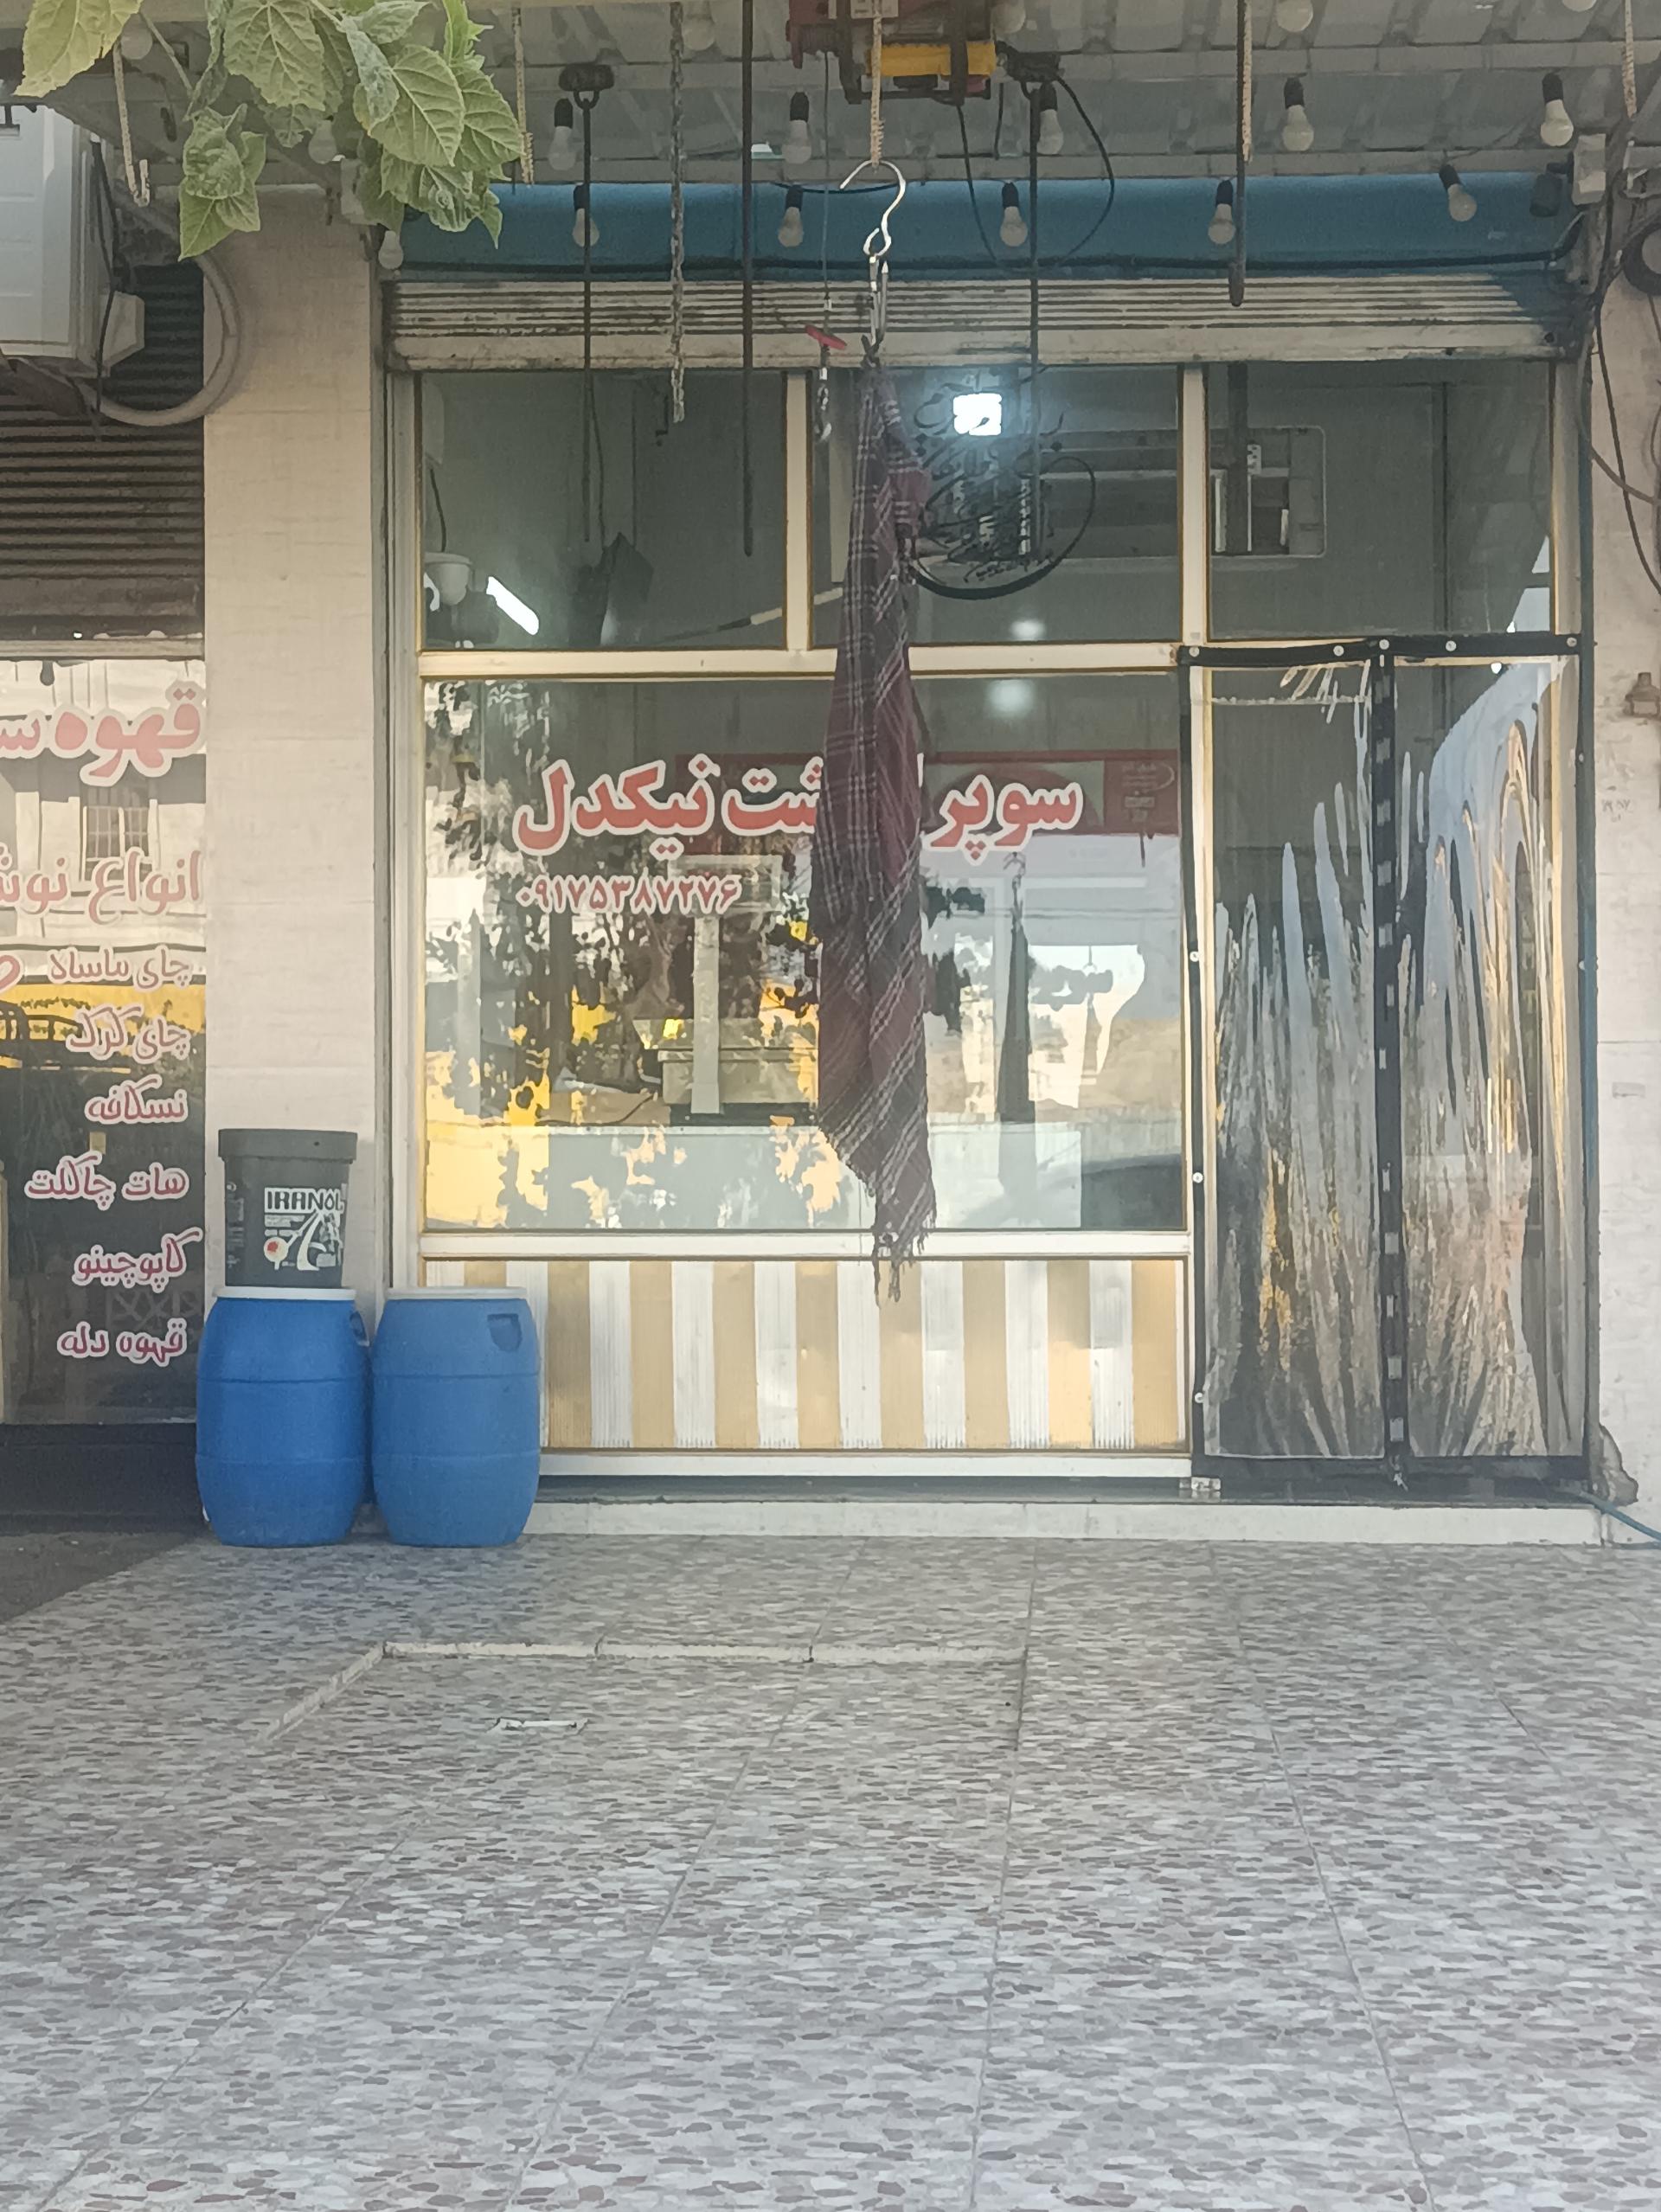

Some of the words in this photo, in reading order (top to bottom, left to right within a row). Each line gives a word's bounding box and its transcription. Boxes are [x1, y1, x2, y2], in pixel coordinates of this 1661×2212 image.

[50, 681, 207, 786] قهوه
[512, 753, 720, 860] نیکدل
[920, 774, 1084, 865] سوپر
[87, 847, 203, 926] انواع
[133, 943, 196, 992] چای
[130, 1015, 190, 1063] چای
[85, 1074, 189, 1125] نسکافه
[24, 1151, 117, 1210] چاکلت
[121, 1162, 189, 1201] هات
[72, 1227, 203, 1293] کاپوچینو
[57, 1321, 110, 1359] دله
[116, 1317, 187, 1367] قهوه
